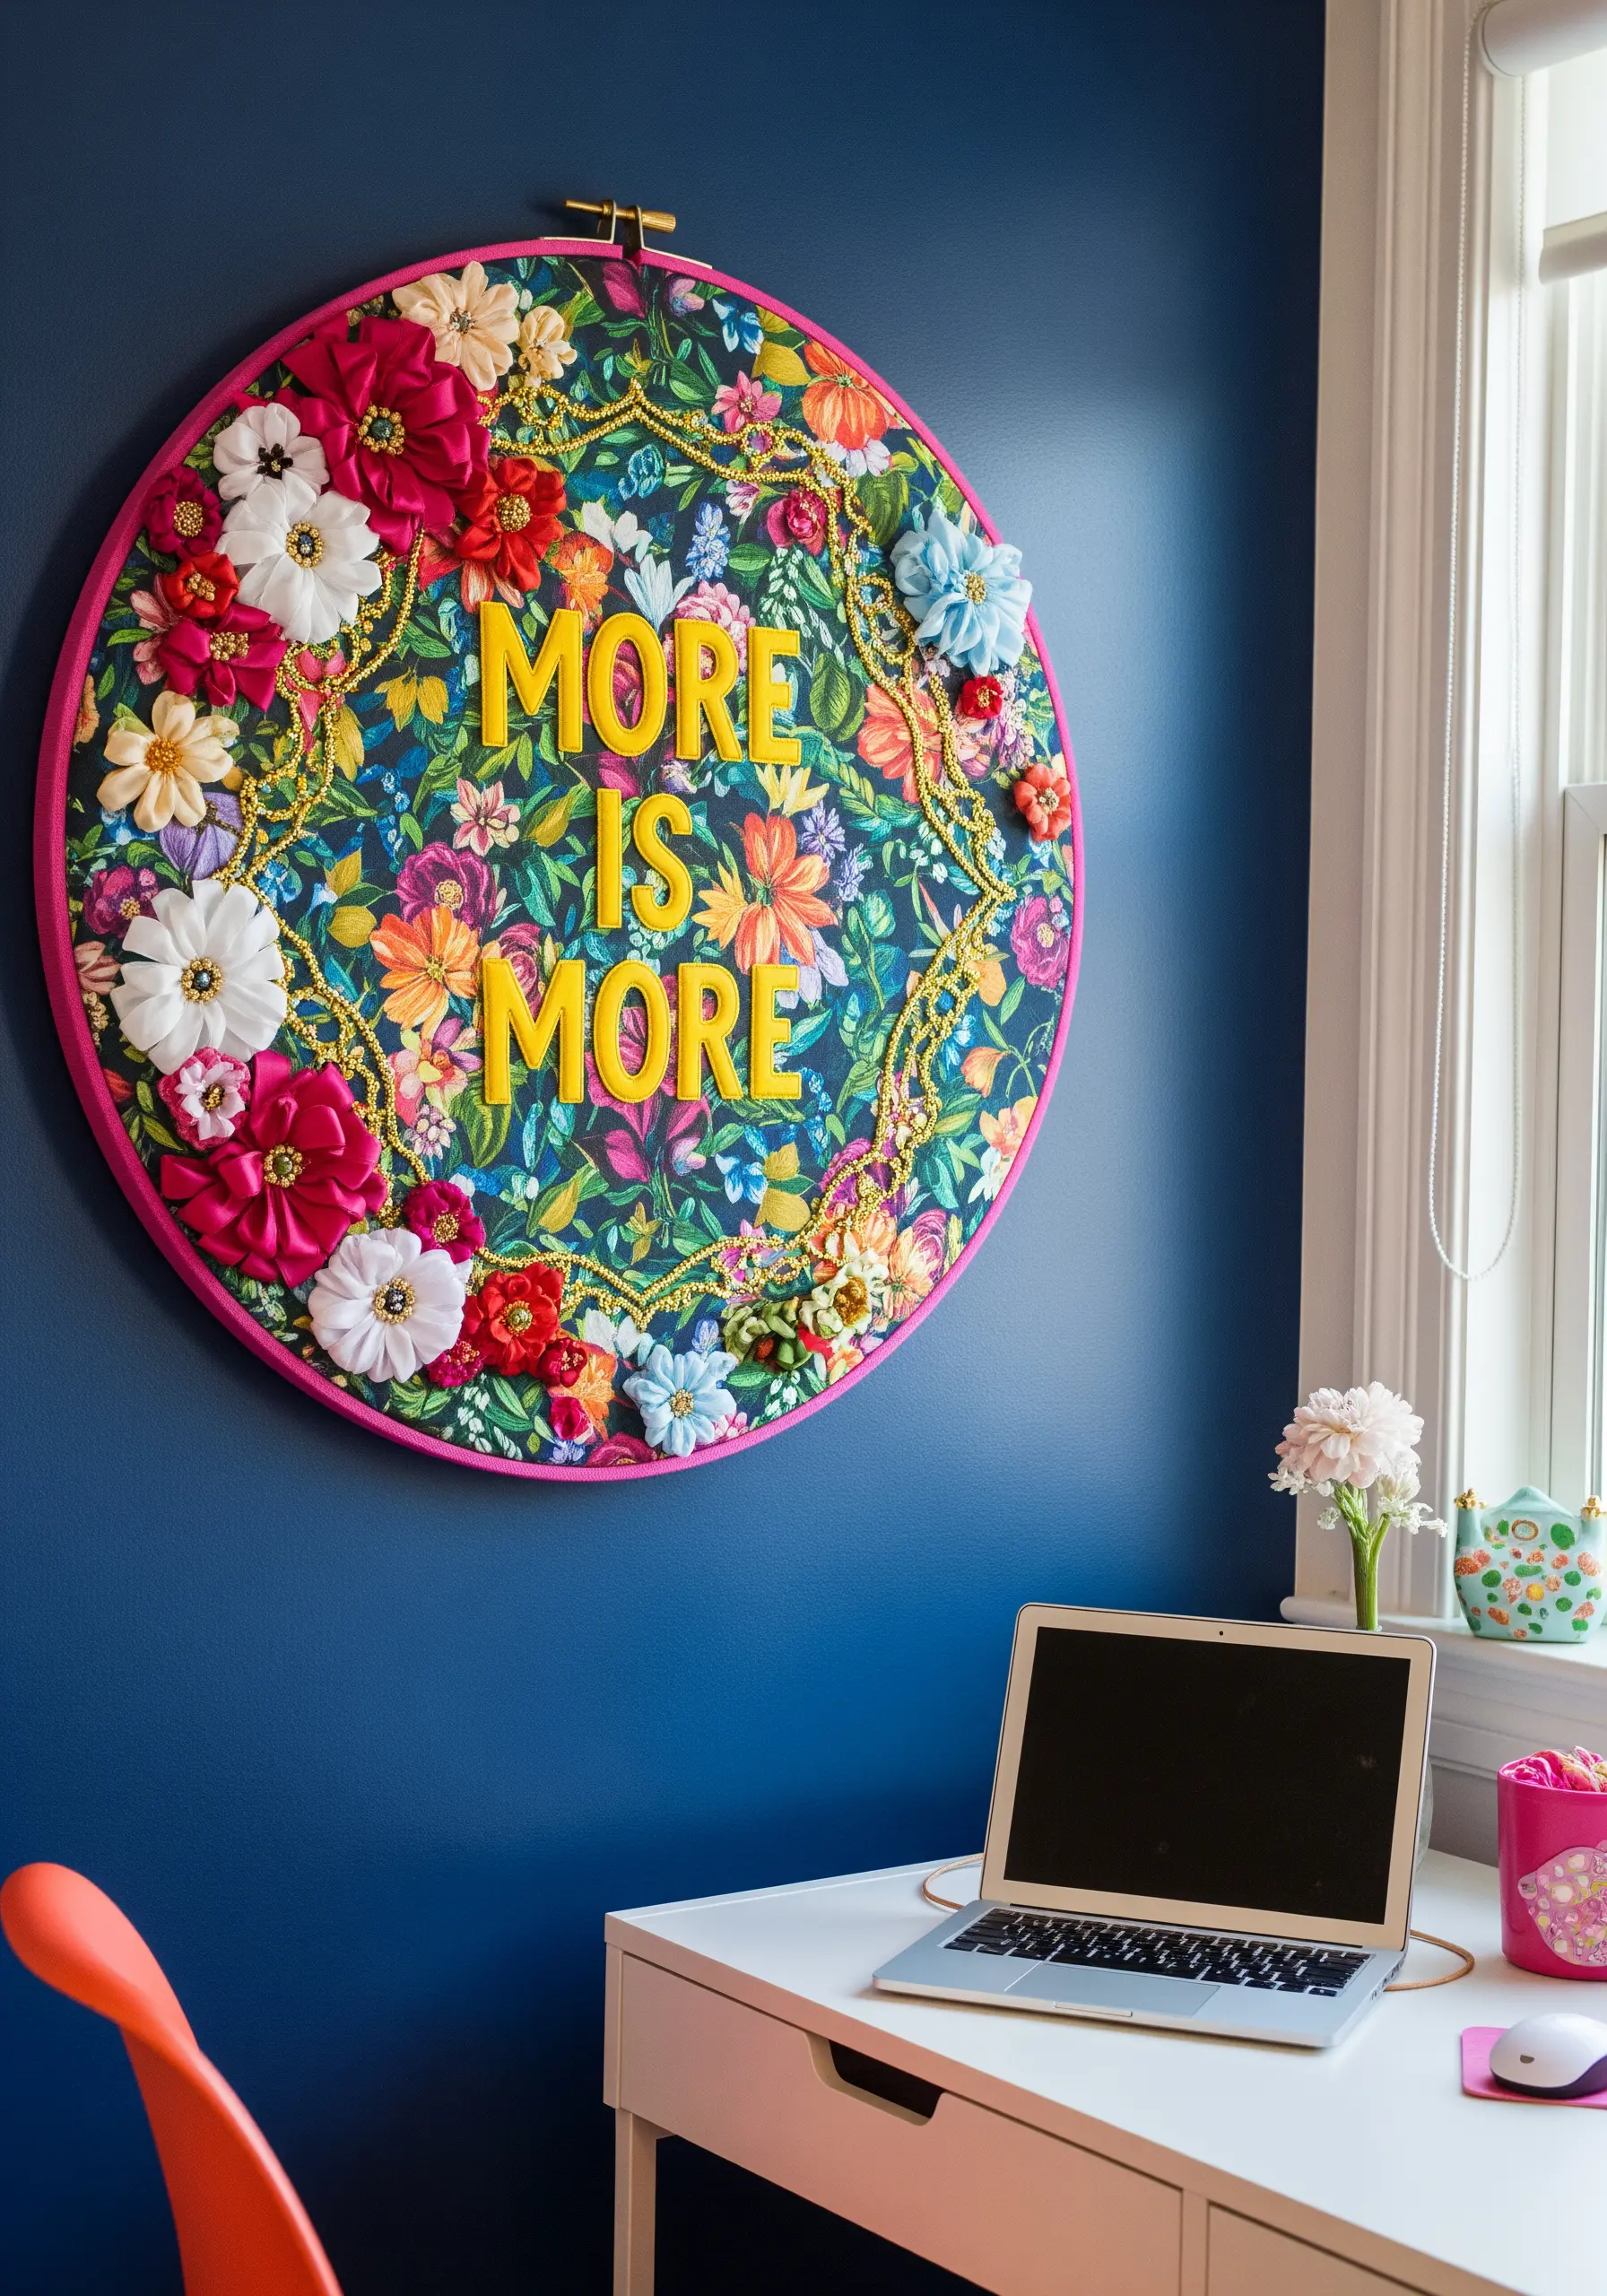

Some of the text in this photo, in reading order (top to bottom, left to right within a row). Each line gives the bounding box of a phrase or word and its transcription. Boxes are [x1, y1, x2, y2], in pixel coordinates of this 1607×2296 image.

[480, 602, 801, 764] MORE
[596, 788, 691, 931] IS
[482, 958, 801, 1104] MORE
